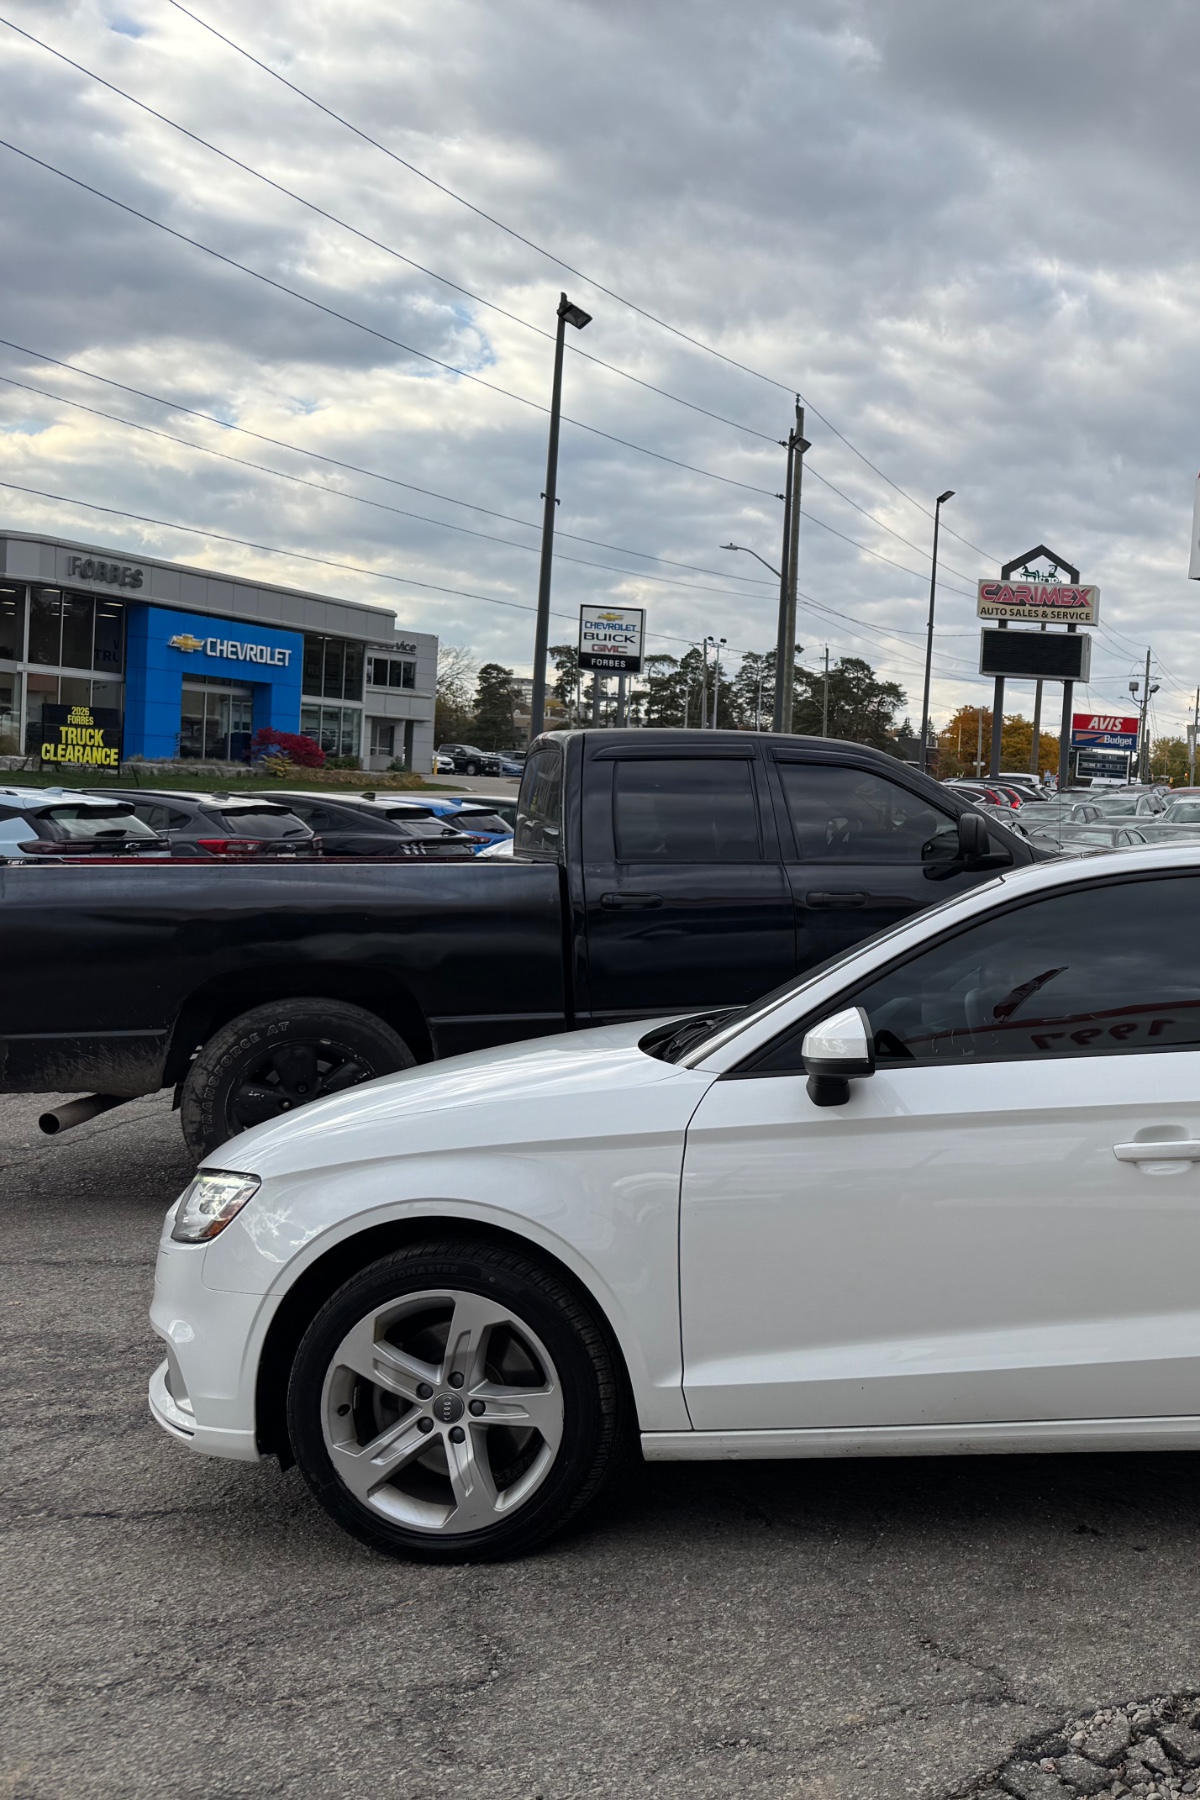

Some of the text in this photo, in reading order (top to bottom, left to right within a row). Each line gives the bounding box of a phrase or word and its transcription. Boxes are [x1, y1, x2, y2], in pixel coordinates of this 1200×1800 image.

[68, 556, 143, 588] FORBES
[980, 583, 1092, 607] CARIMEX
[980, 607, 1091, 620] AUTO SALES & SERVICE
[585, 621, 637, 631] CHEVROLET
[583, 632, 636, 643] BUICK
[206, 637, 292, 667] CHEVROLET
[592, 644, 628, 654] GMC
[591, 658, 626, 668] FORBES
[67, 715, 94, 726] FORBES
[1087, 716, 1123, 731] AVIS
[60, 726, 104, 746] TRUCK
[1104, 734, 1133, 746] Budget
[41, 743, 119, 766] CLEARANCE
[201, 1021, 290, 1135] TRANSFORCE AT
